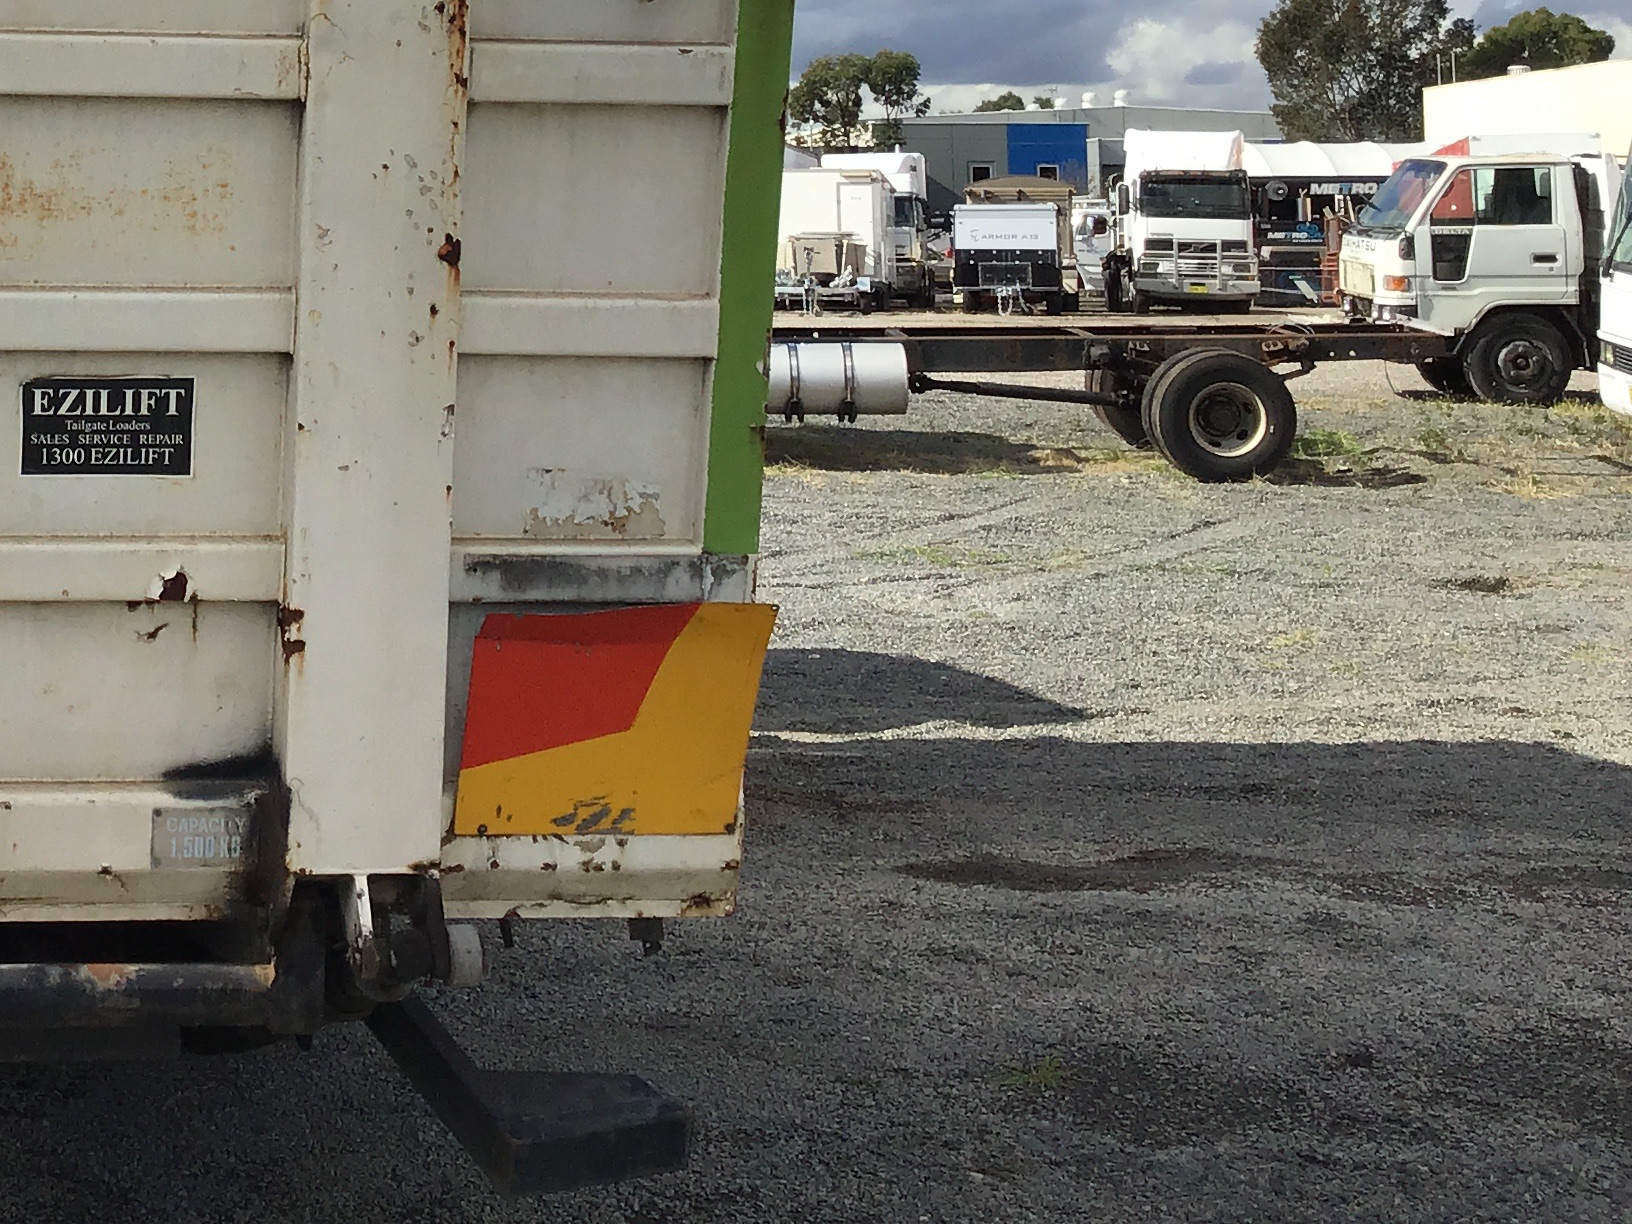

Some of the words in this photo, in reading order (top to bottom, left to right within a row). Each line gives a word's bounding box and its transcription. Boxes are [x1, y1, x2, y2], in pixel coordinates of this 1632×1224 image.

[31, 388, 186, 416] EZILIFT
[65, 420, 107, 432] Tailgate
[109, 420, 151, 431] Loaders
[30, 433, 70, 445] SALES
[78, 433, 131, 445] SERVICE
[139, 433, 184, 445] REPAIR
[41, 447, 85, 465] 1300
[90, 447, 175, 465] EZILIFT
